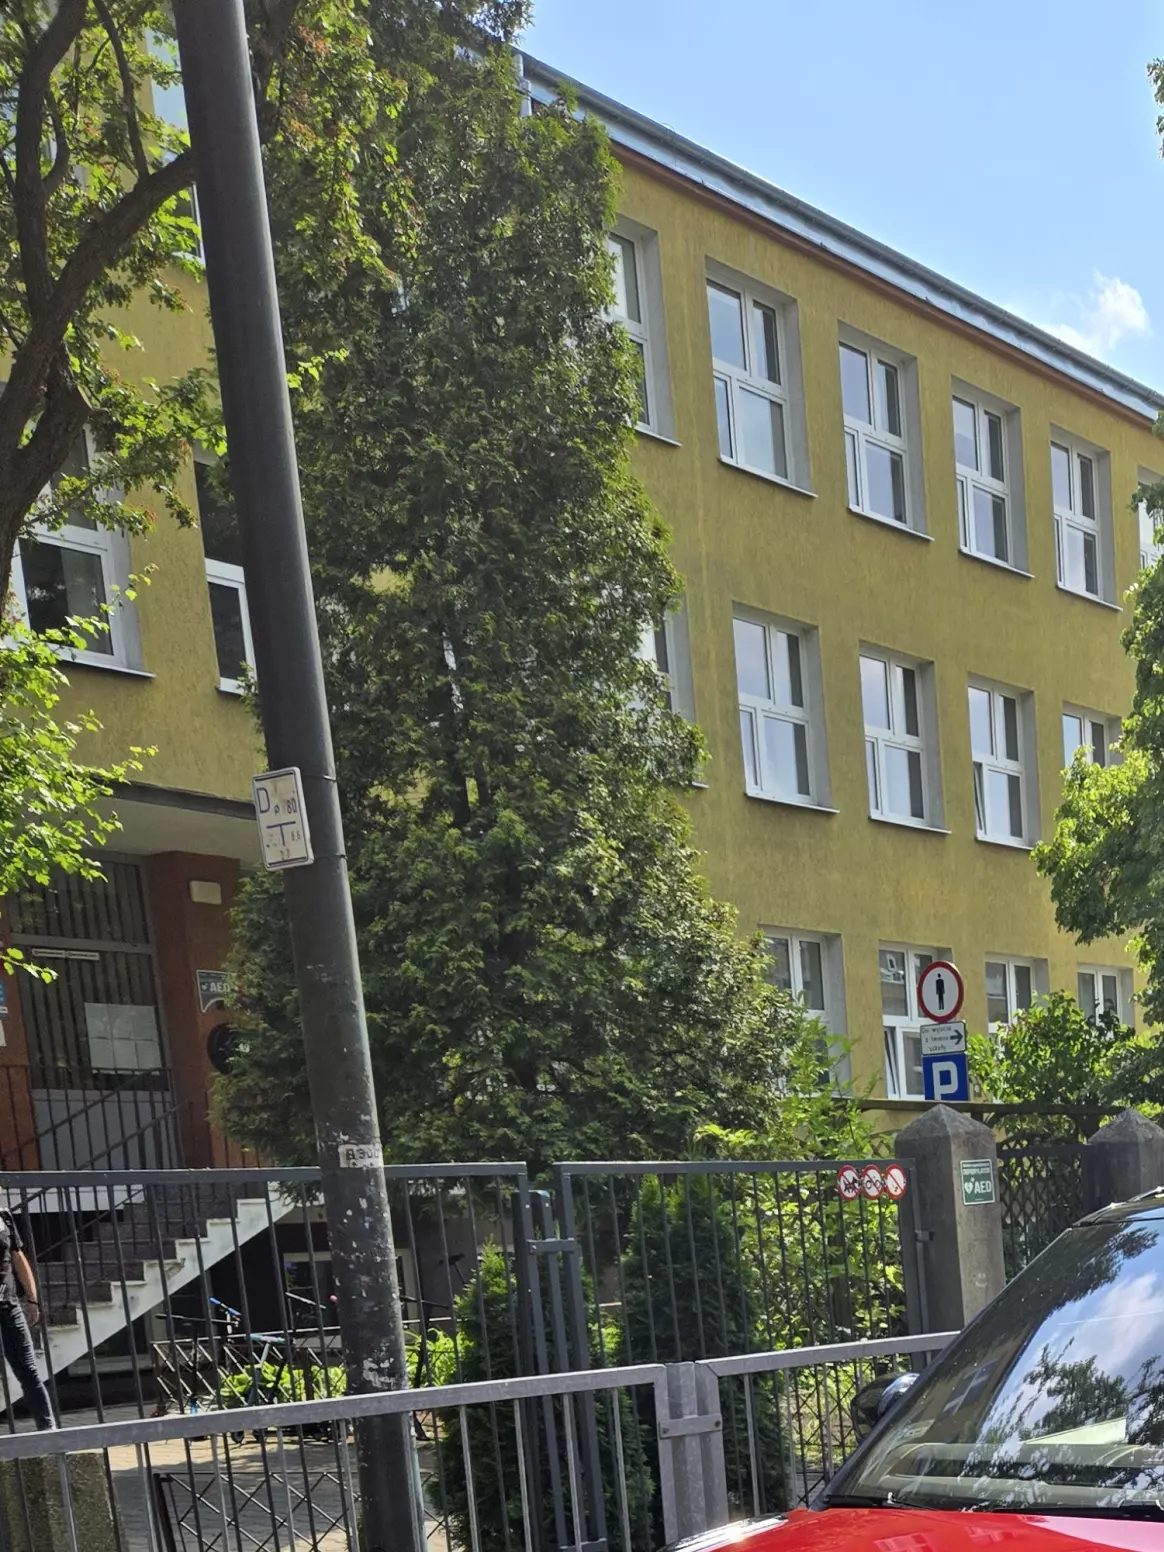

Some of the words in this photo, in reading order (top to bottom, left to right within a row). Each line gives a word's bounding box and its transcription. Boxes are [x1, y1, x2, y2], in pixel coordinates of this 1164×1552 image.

[256, 788, 271, 814] D
[210, 982, 231, 993] AED
[932, 1061, 959, 1101] P
[974, 1181, 992, 1194] AED
